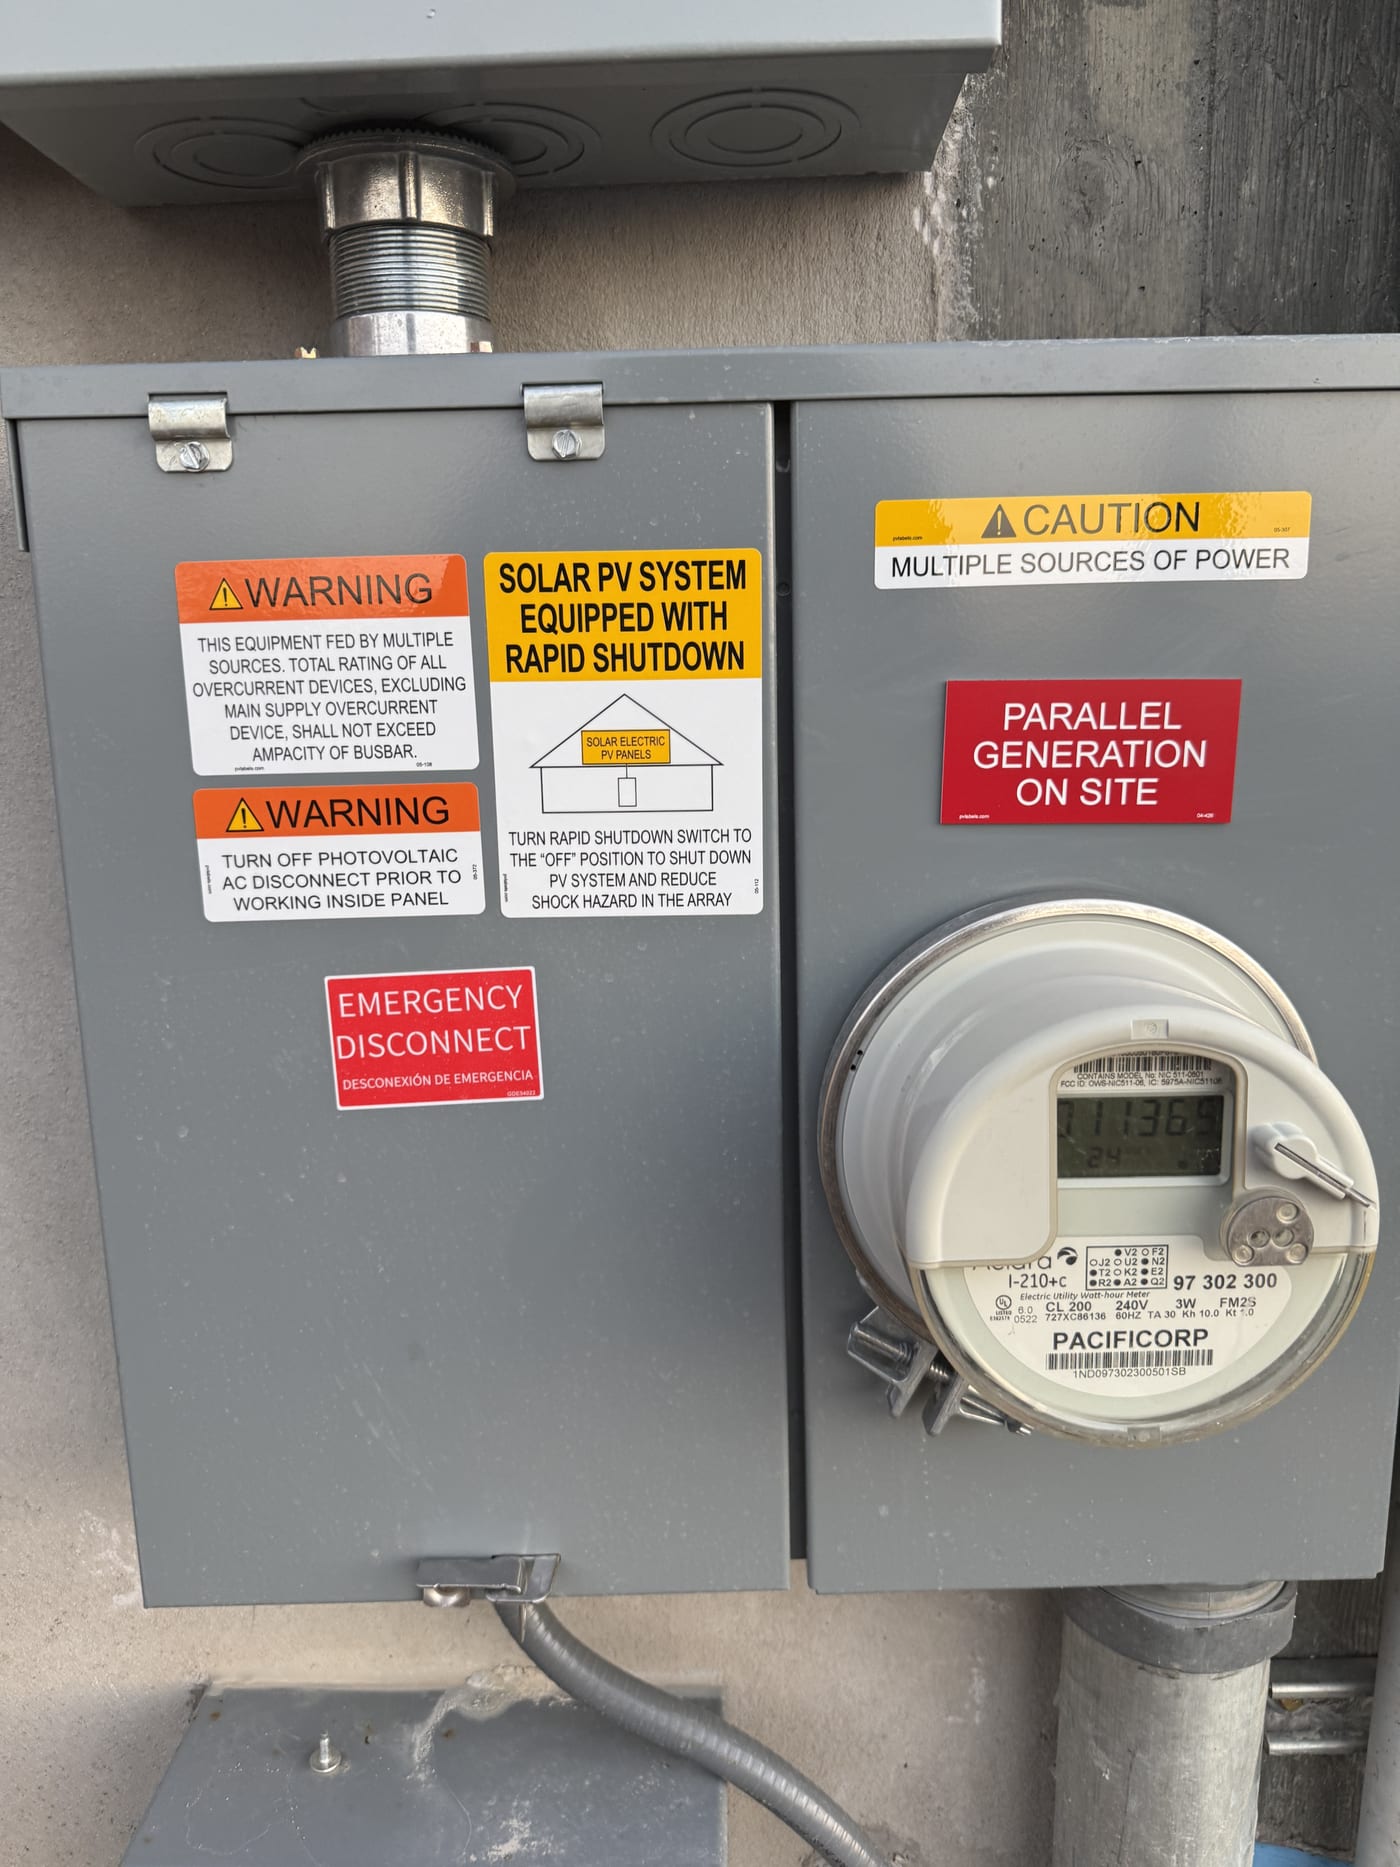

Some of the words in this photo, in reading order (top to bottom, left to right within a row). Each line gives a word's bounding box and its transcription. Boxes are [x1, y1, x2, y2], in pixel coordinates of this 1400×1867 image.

[1024, 501, 1200, 536] CAUTION
[892, 554, 1012, 577] MULTIPLE
[1020, 550, 1145, 574] SOURCES
[1154, 550, 1187, 571] OF
[1196, 548, 1290, 570] POWER
[499, 563, 591, 593] SOLAR
[598, 562, 632, 591] PV
[639, 560, 746, 591] SYSTEM
[244, 573, 432, 607] WARNING
[520, 602, 654, 634] EQUIPPED
[661, 601, 727, 631] WITH
[198, 637, 231, 652] THIS
[235, 635, 322, 652] EQUIPMENT
[326, 634, 355, 649] FED
[360, 633, 379, 648] BY
[383, 632, 453, 648] MULTIPLE
[209, 658, 285, 674] SOURCES.
[289, 657, 335, 672] TOTAL
[339, 655, 393, 671] RATING
[397, 655, 417, 670] OF
[420, 654, 447, 669] ALL
[506, 643, 585, 673] RAPID
[593, 641, 744, 673] SHUTDOWN
[193, 680, 305, 697] OVERCURRENT
[309, 678, 377, 695] DEVICES,
[381, 676, 466, 693] EXCLUDING
[224, 704, 261, 719] MAIN
[265, 702, 321, 718] SUPPLY
[325, 700, 438, 716] OVERCURRENT
[1003, 701, 1182, 731] PARALLEL
[230, 725, 289, 741] DEVICE,
[292, 724, 338, 739] SHALL
[342, 722, 373, 738] NOT
[377, 721, 436, 737] EXCEED
[586, 737, 618, 748] SOLAR
[620, 735, 665, 747] ELECTRIC
[252, 746, 324, 762] AMPACITY
[329, 745, 350, 761] OF
[353, 744, 417, 760] BUSBAR.
[601, 750, 616, 760] PV
[618, 749, 651, 760] PANELS
[973, 739, 1207, 769] GENERATION
[1016, 778, 1068, 806] ON
[1080, 778, 1159, 806] SITE
[266, 796, 449, 828] WARNING
[509, 831, 546, 846] TURN
[550, 830, 591, 846] RAPID
[595, 829, 672, 845] SHUTDOWN
[677, 829, 730, 844] SWITCH
[733, 828, 752, 843] TO
[222, 854, 271, 869] TURN
[277, 852, 312, 867] OFF
[319, 848, 458, 866] PHOTOVOLTAIC
[510, 853, 536, 867] THE
[540, 852, 576, 867] “OFF”
[580, 851, 643, 866] POSITION
[647, 851, 665, 865] TO
[669, 850, 705, 865] SHUT
[709, 849, 751, 864] DOWN
[222, 876, 247, 890] AC
[253, 872, 371, 889] DISCONNECT
[376, 871, 432, 886] PRIOR
[437, 870, 461, 884] TO
[550, 874, 567, 888] PV
[571, 873, 627, 888] SYSTEM
[629, 872, 657, 887] AND
[660, 871, 716, 886] REDUCE
[233, 896, 321, 912] WORKING
[327, 893, 385, 909] INSIDE
[391, 891, 449, 907] PANEL
[532, 894, 579, 910] SHOCK
[583, 894, 638, 909] HAZARD
[641, 893, 655, 907] IN
[659, 893, 685, 907] THE
[687, 892, 732, 907] ARRAY
[339, 984, 523, 1018] EMERGENCY
[336, 1026, 531, 1060] DISCONNECT
[343, 1073, 432, 1090] DESCONEXIÓN
[435, 1074, 451, 1086] DE
[454, 1069, 534, 1085] EMERGENCIA
[1099, 1258, 1111, 1266] J2
[1124, 1258, 1138, 1266] U2
[1152, 1257, 1165, 1265] N2
[1124, 1248, 1138, 1256] V2
[1152, 1247, 1164, 1255] F2
[1124, 1268, 1137, 1276] K2
[1151, 1267, 1164, 1275] E2
[1173, 1275, 1195, 1290] 97
[1203, 1274, 1236, 1290] 302
[1243, 1273, 1278, 1289] 300
[1098, 1279, 1111, 1287] R2
[1124, 1278, 1137, 1286] A2
[1151, 1277, 1165, 1286] Q2
[1020, 1292, 1051, 1301] Electric
[1053, 1291, 1078, 1302] Utility
[1080, 1290, 1124, 1299] Watt-hour
[1126, 1290, 1150, 1299] Meter
[1046, 1302, 1064, 1312] CL
[1069, 1301, 1092, 1312] 200
[1115, 1299, 1149, 1311] 240V
[1176, 1298, 1197, 1309] 3W
[1219, 1296, 1256, 1308] FM2S
[1014, 1315, 1038, 1324] 0522
[1115, 1311, 1142, 1320] 60HZ
[1148, 1311, 1162, 1320] TA
[1164, 1310, 1176, 1319] 30
[1182, 1309, 1196, 1318] Kh
[1200, 1309, 1219, 1318] 10.0
[1226, 1308, 1237, 1317] Kt
[1052, 1328, 1209, 1350] PACIFICORP
